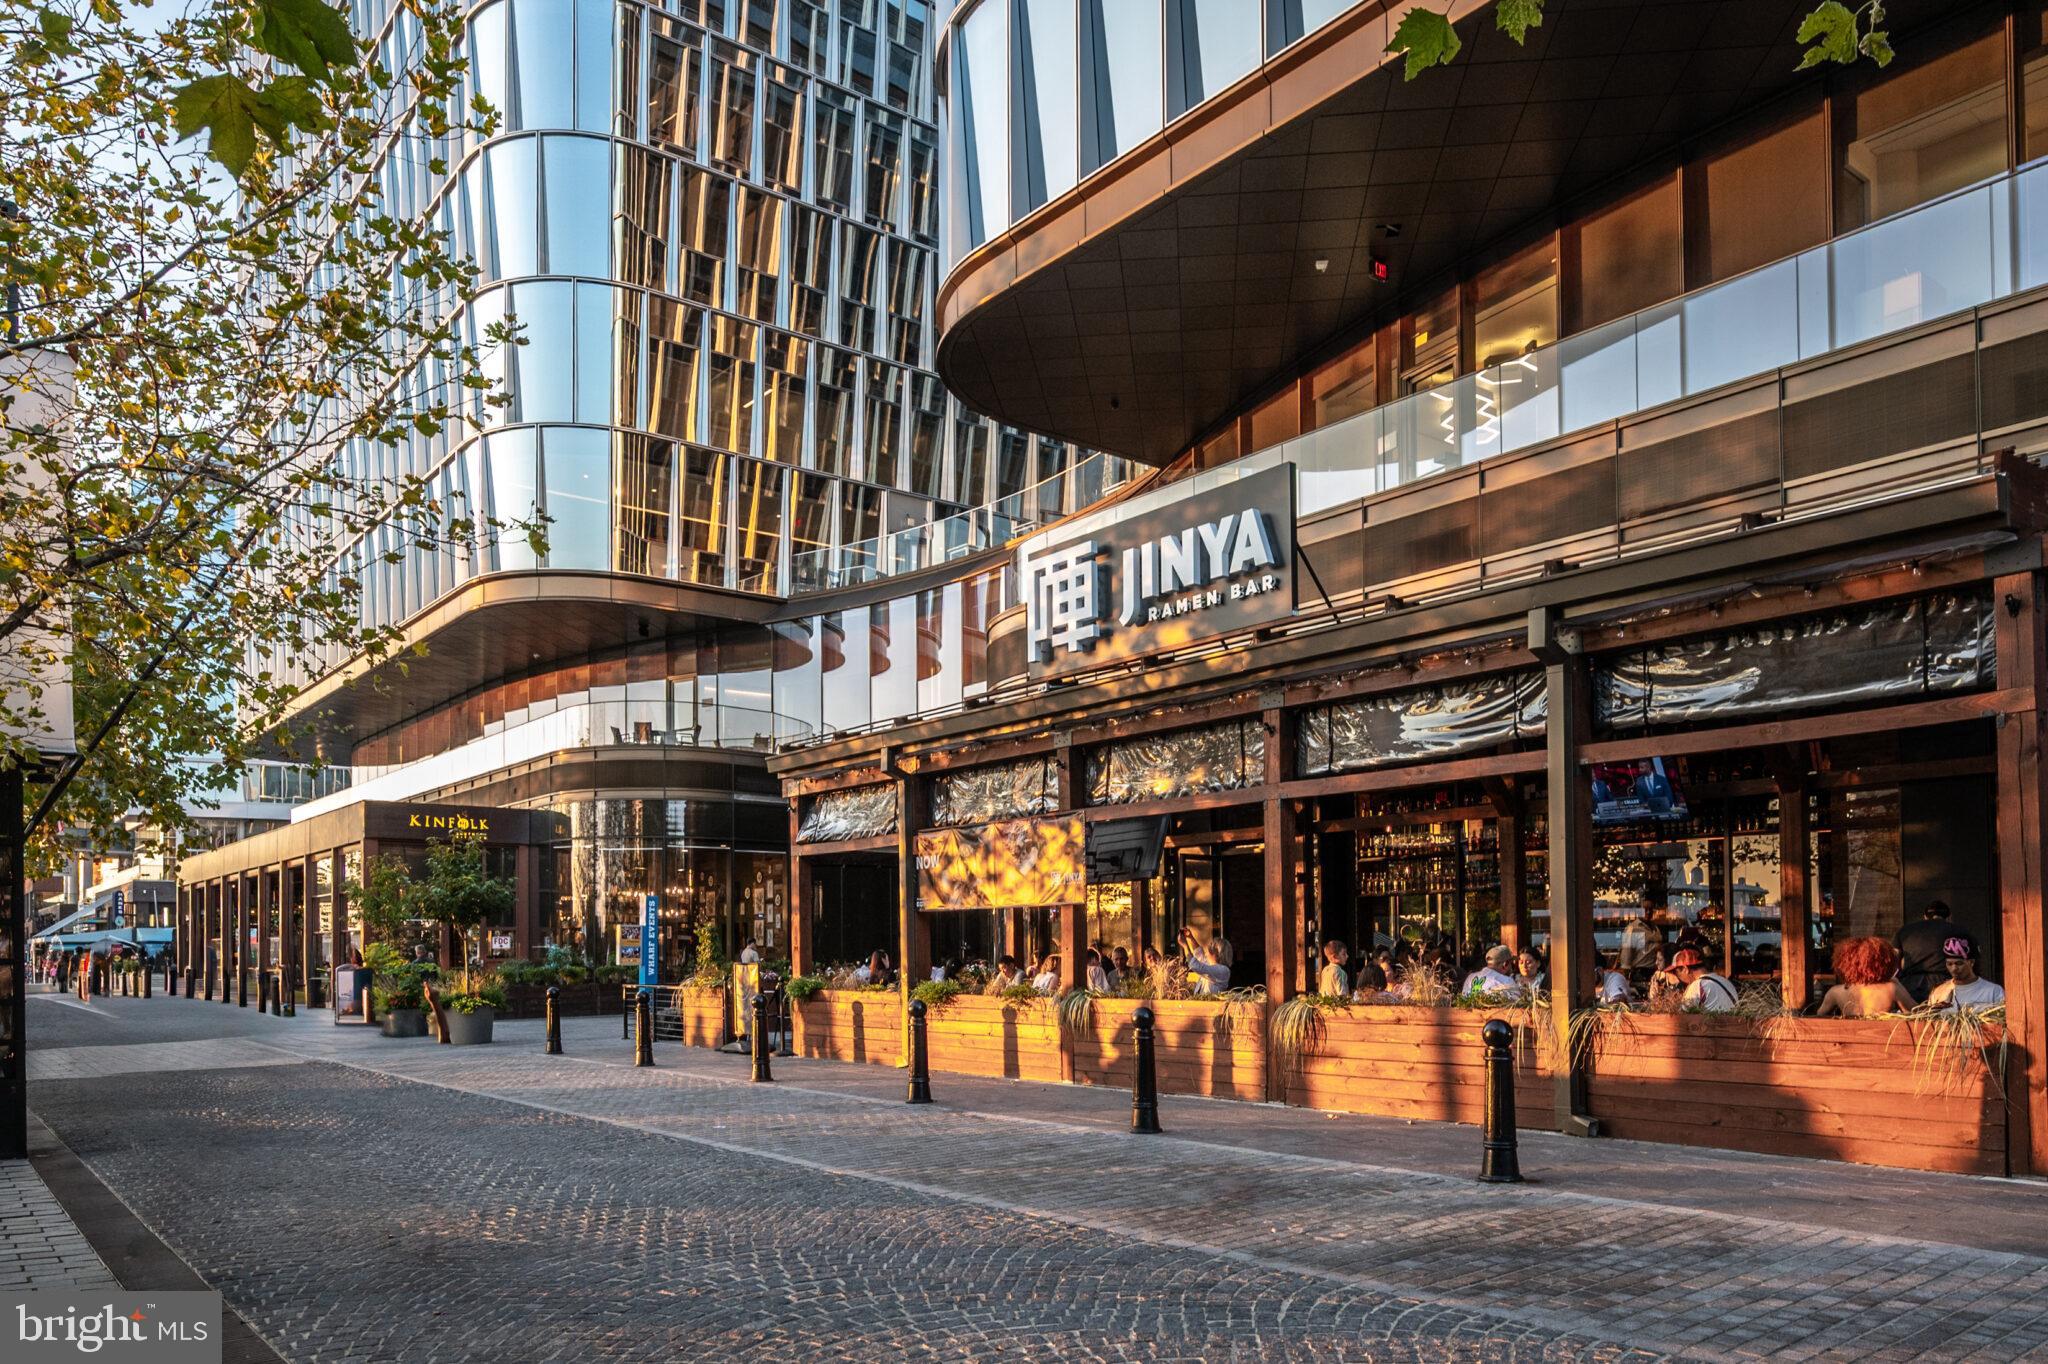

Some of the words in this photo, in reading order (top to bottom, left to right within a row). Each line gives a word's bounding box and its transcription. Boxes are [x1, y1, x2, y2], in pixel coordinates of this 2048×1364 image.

[1118, 508, 1275, 627] JINYA
[1148, 589, 1219, 622] RAMEN
[1230, 574, 1274, 600] BAR
[409, 814, 489, 830] KINFOLK
[916, 855, 940, 869] NOW
[648, 900, 656, 939] EVENTS
[648, 941, 656, 976] WHARF
